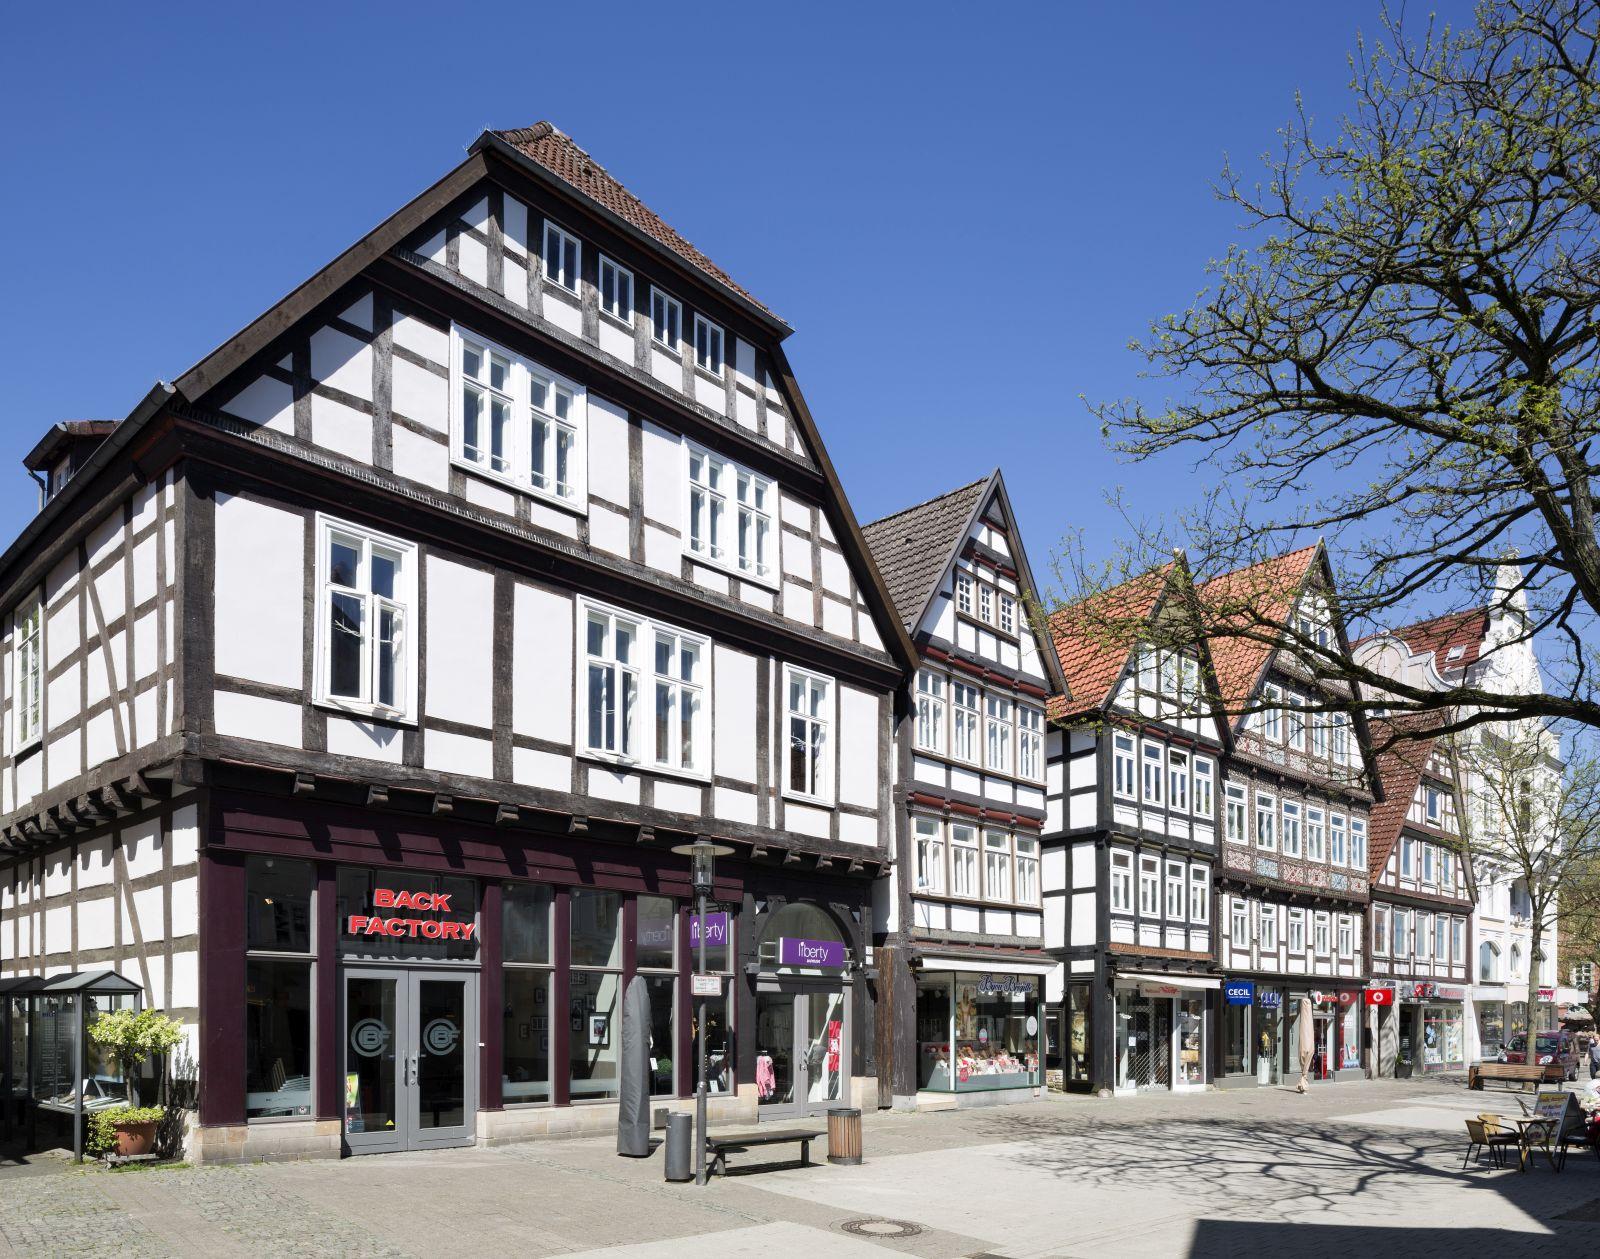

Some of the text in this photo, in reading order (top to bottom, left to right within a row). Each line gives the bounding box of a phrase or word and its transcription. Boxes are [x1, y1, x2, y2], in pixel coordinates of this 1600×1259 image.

[373, 888, 452, 912] BACK
[348, 915, 476, 940] FACTORY
[798, 941, 829, 962] liberty
[1228, 988, 1251, 996] CECIL
